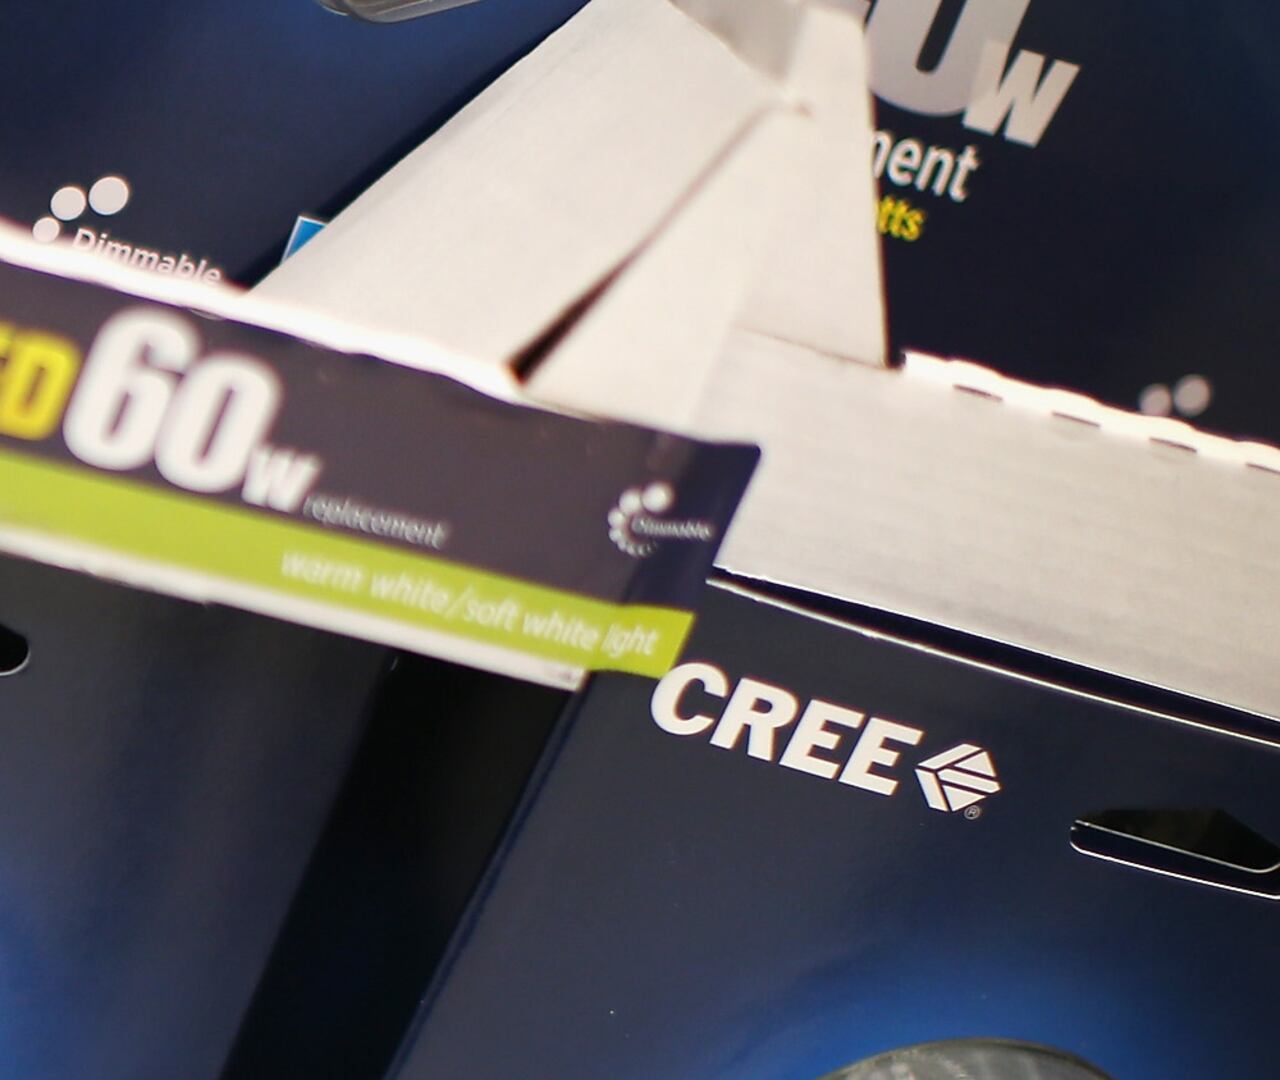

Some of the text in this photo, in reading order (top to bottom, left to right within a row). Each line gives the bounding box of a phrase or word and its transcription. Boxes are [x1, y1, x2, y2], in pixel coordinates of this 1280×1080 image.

[72, 227, 222, 284] Dimmable
[282, 550, 364, 594] warm
[522, 610, 598, 651] white
[649, 661, 924, 797] CREE
